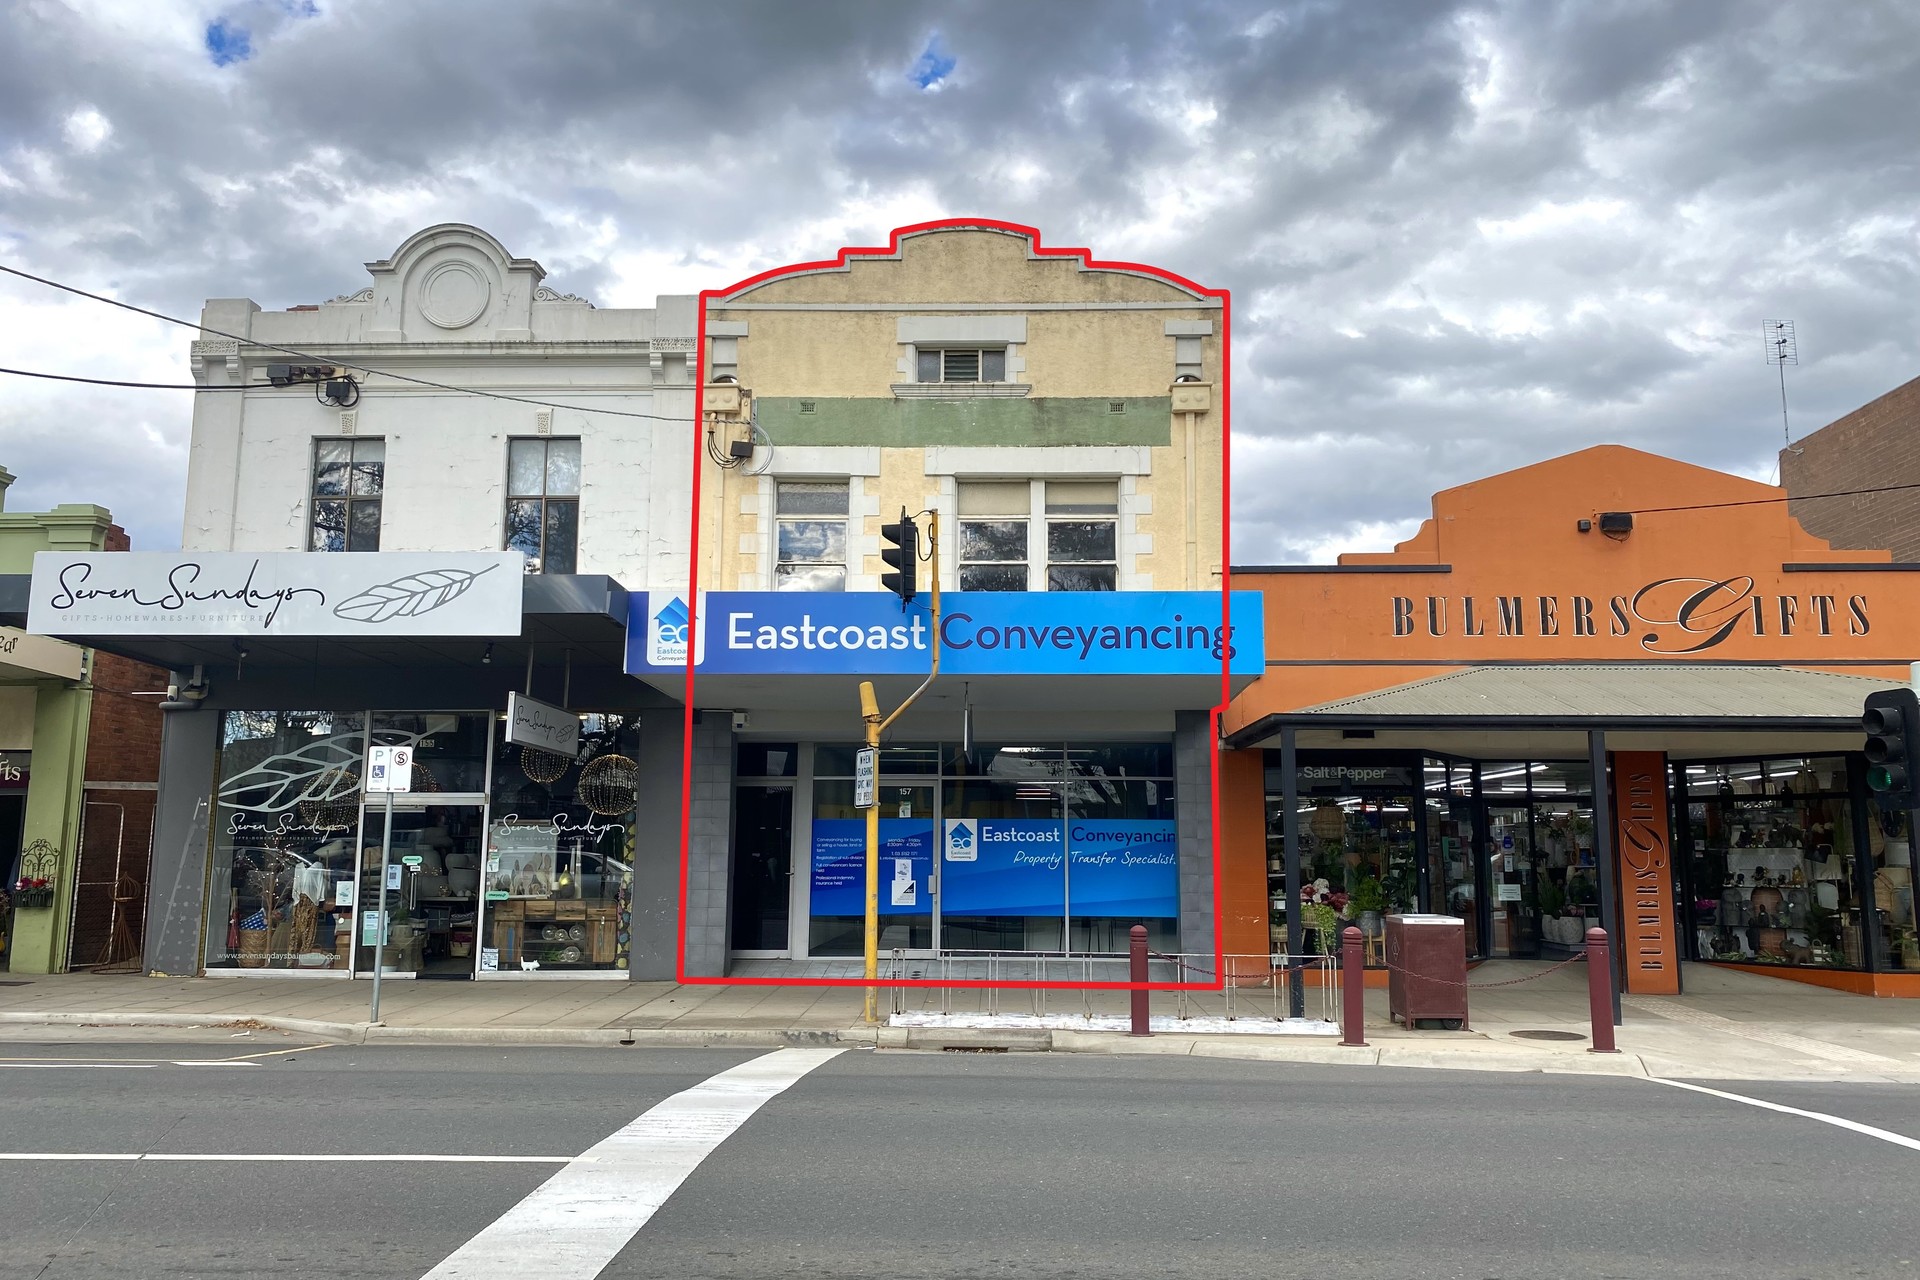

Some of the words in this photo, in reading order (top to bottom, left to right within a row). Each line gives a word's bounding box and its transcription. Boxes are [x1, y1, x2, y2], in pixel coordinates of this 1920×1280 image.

[51, 563, 161, 609] Seven
[161, 559, 325, 628] Sundays
[1392, 595, 1630, 637] BULMERS
[1633, 576, 1871, 654] GIFTS
[728, 612, 927, 650] Eastcoast
[940, 612, 1237, 661] Conveyancing
[375, 750, 384, 761] P
[899, 788, 912, 796] 157
[227, 812, 277, 834] Seven
[500, 813, 551, 835] Seven
[550, 811, 625, 843] Sundays
[982, 826, 1060, 842] Eastcoast
[1621, 773, 1667, 871] GIFTS
[1013, 850, 1062, 870] Property
[1071, 851, 1116, 866] Transfer
[1121, 851, 1176, 866] Specialist
[1635, 869, 1664, 971] BULMERS
